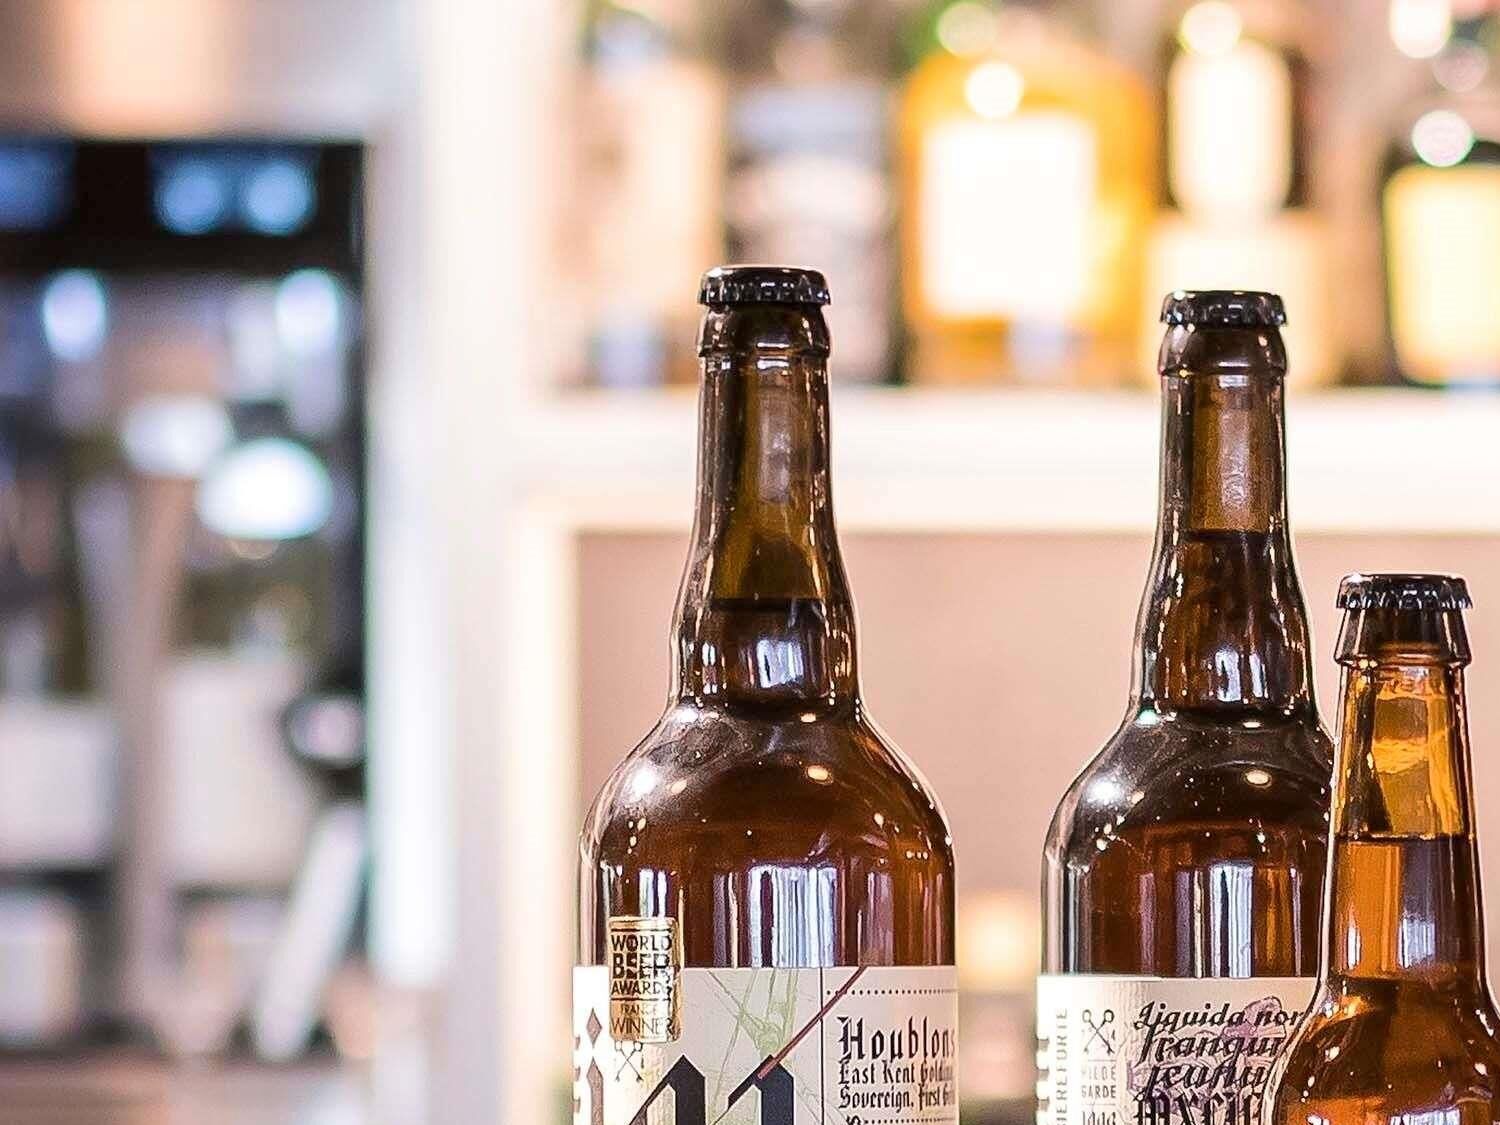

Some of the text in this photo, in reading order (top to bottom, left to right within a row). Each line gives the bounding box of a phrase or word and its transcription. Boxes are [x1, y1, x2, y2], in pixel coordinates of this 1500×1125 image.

[611, 934, 673, 951] WORLD
[612, 953, 673, 980] BEER
[611, 980, 673, 995] AWARDS
[611, 1017, 673, 1035] WINNER
